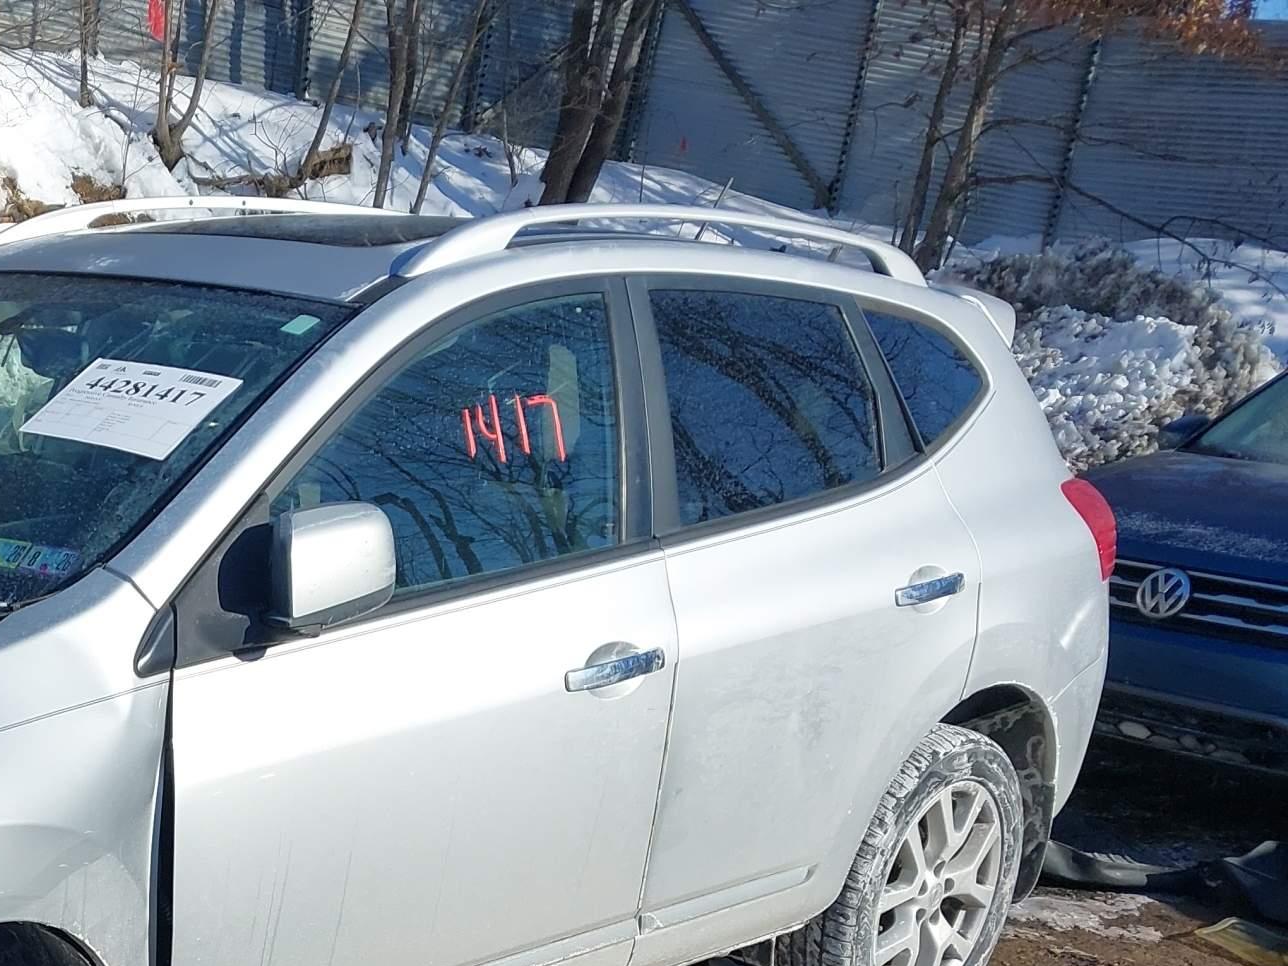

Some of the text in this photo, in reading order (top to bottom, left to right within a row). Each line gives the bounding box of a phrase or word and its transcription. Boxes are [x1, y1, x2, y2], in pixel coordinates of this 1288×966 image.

[85, 376, 207, 407] 44281417
[461, 393, 567, 463] 1417
[27, 551, 41, 567] 8
